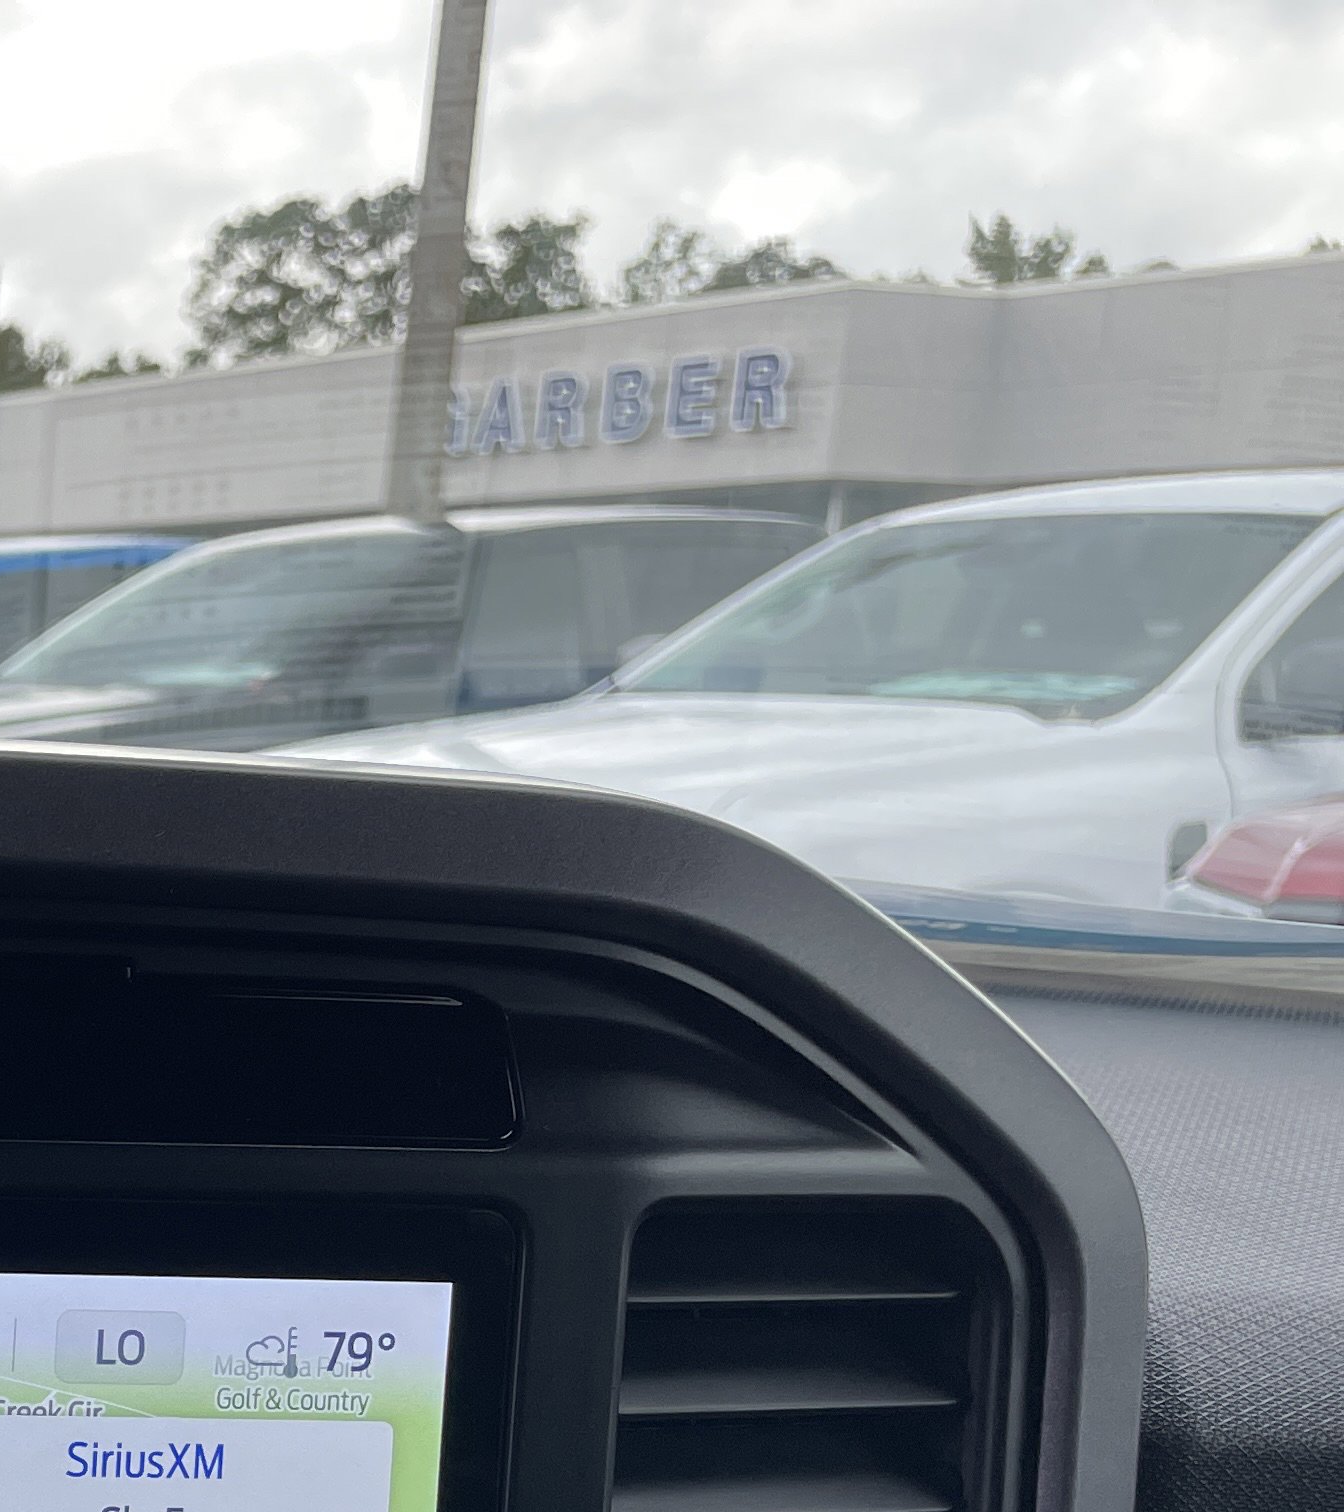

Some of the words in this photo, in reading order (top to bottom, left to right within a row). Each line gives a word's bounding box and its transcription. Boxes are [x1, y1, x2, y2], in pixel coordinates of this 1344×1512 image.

[95, 1328, 146, 1366] LO
[323, 1331, 395, 1372] 79°
[217, 1387, 262, 1410] Golf
[266, 1388, 281, 1410] &
[287, 1389, 370, 1416] Country
[65, 1441, 225, 1480] SiriusXM
